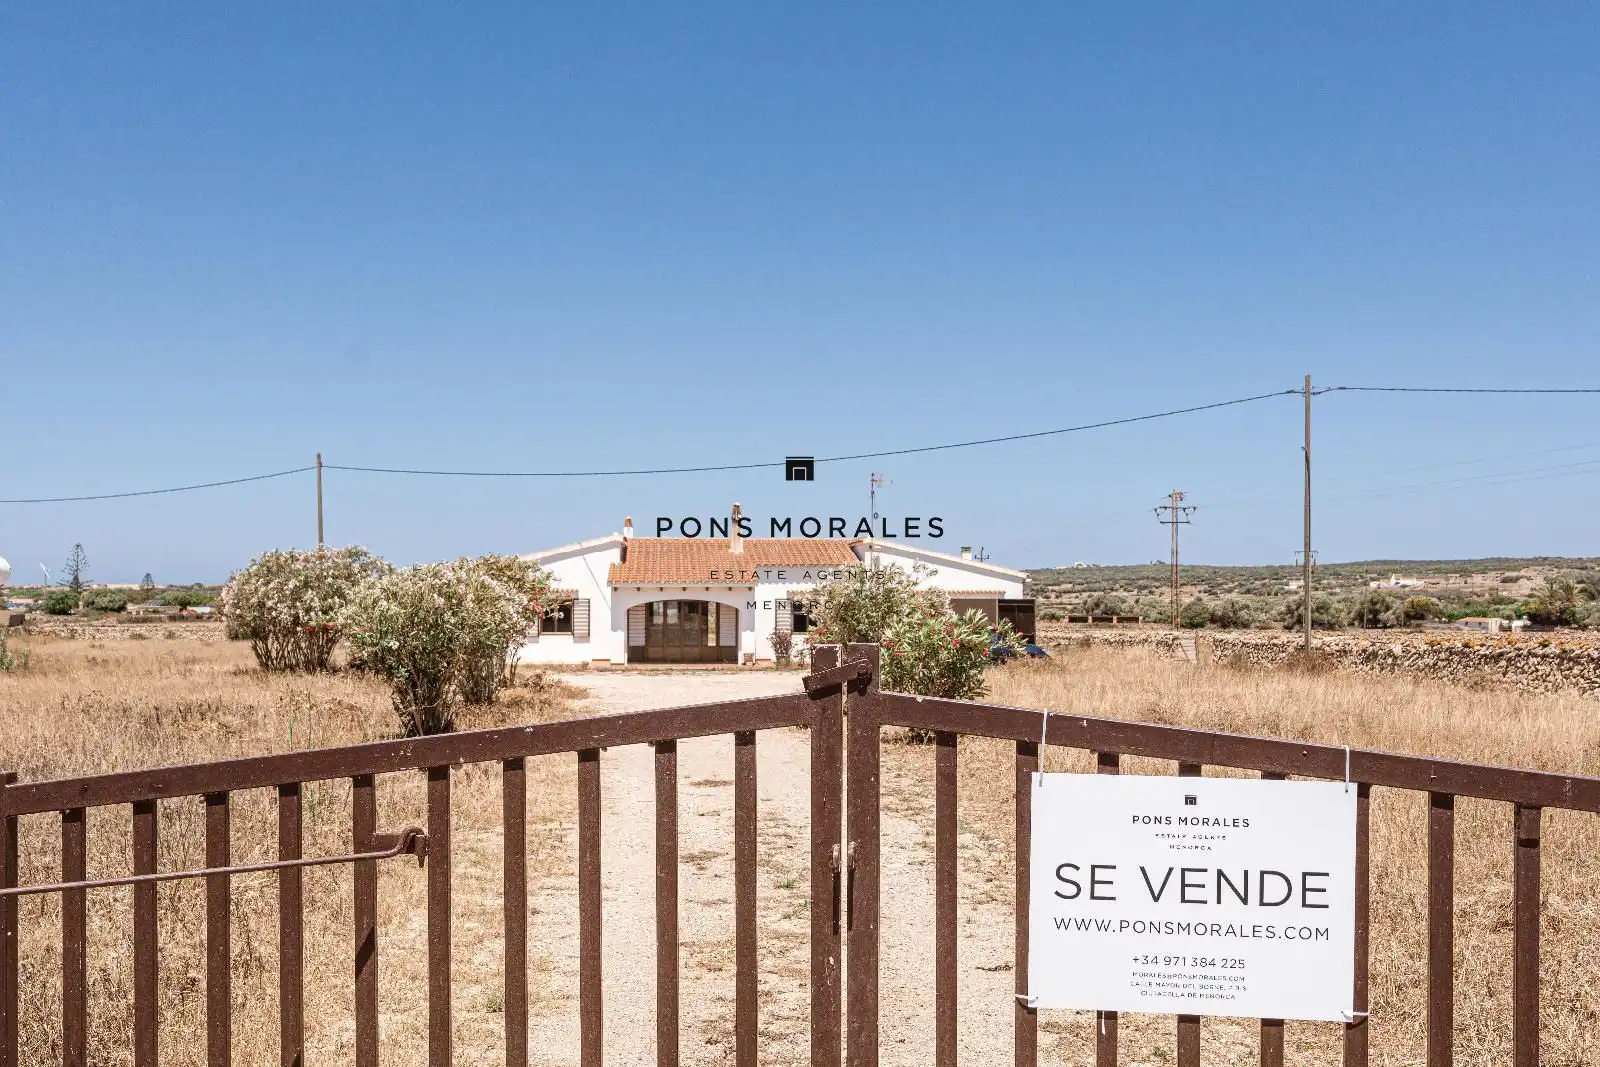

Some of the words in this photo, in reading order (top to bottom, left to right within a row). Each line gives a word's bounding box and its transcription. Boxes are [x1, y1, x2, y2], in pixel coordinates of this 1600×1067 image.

[1132, 815, 1172, 825] PONS
[1178, 816, 1250, 828] MORALES
[1054, 863, 1117, 902] SE
[1139, 866, 1330, 909] VENDE
[1054, 917, 1330, 942] WWW.PONSMORALES.COM
[1132, 955, 1159, 965] +34
[1163, 956, 1187, 966] 971
[1191, 957, 1217, 968] 384
[1220, 958, 1246, 969] 225
